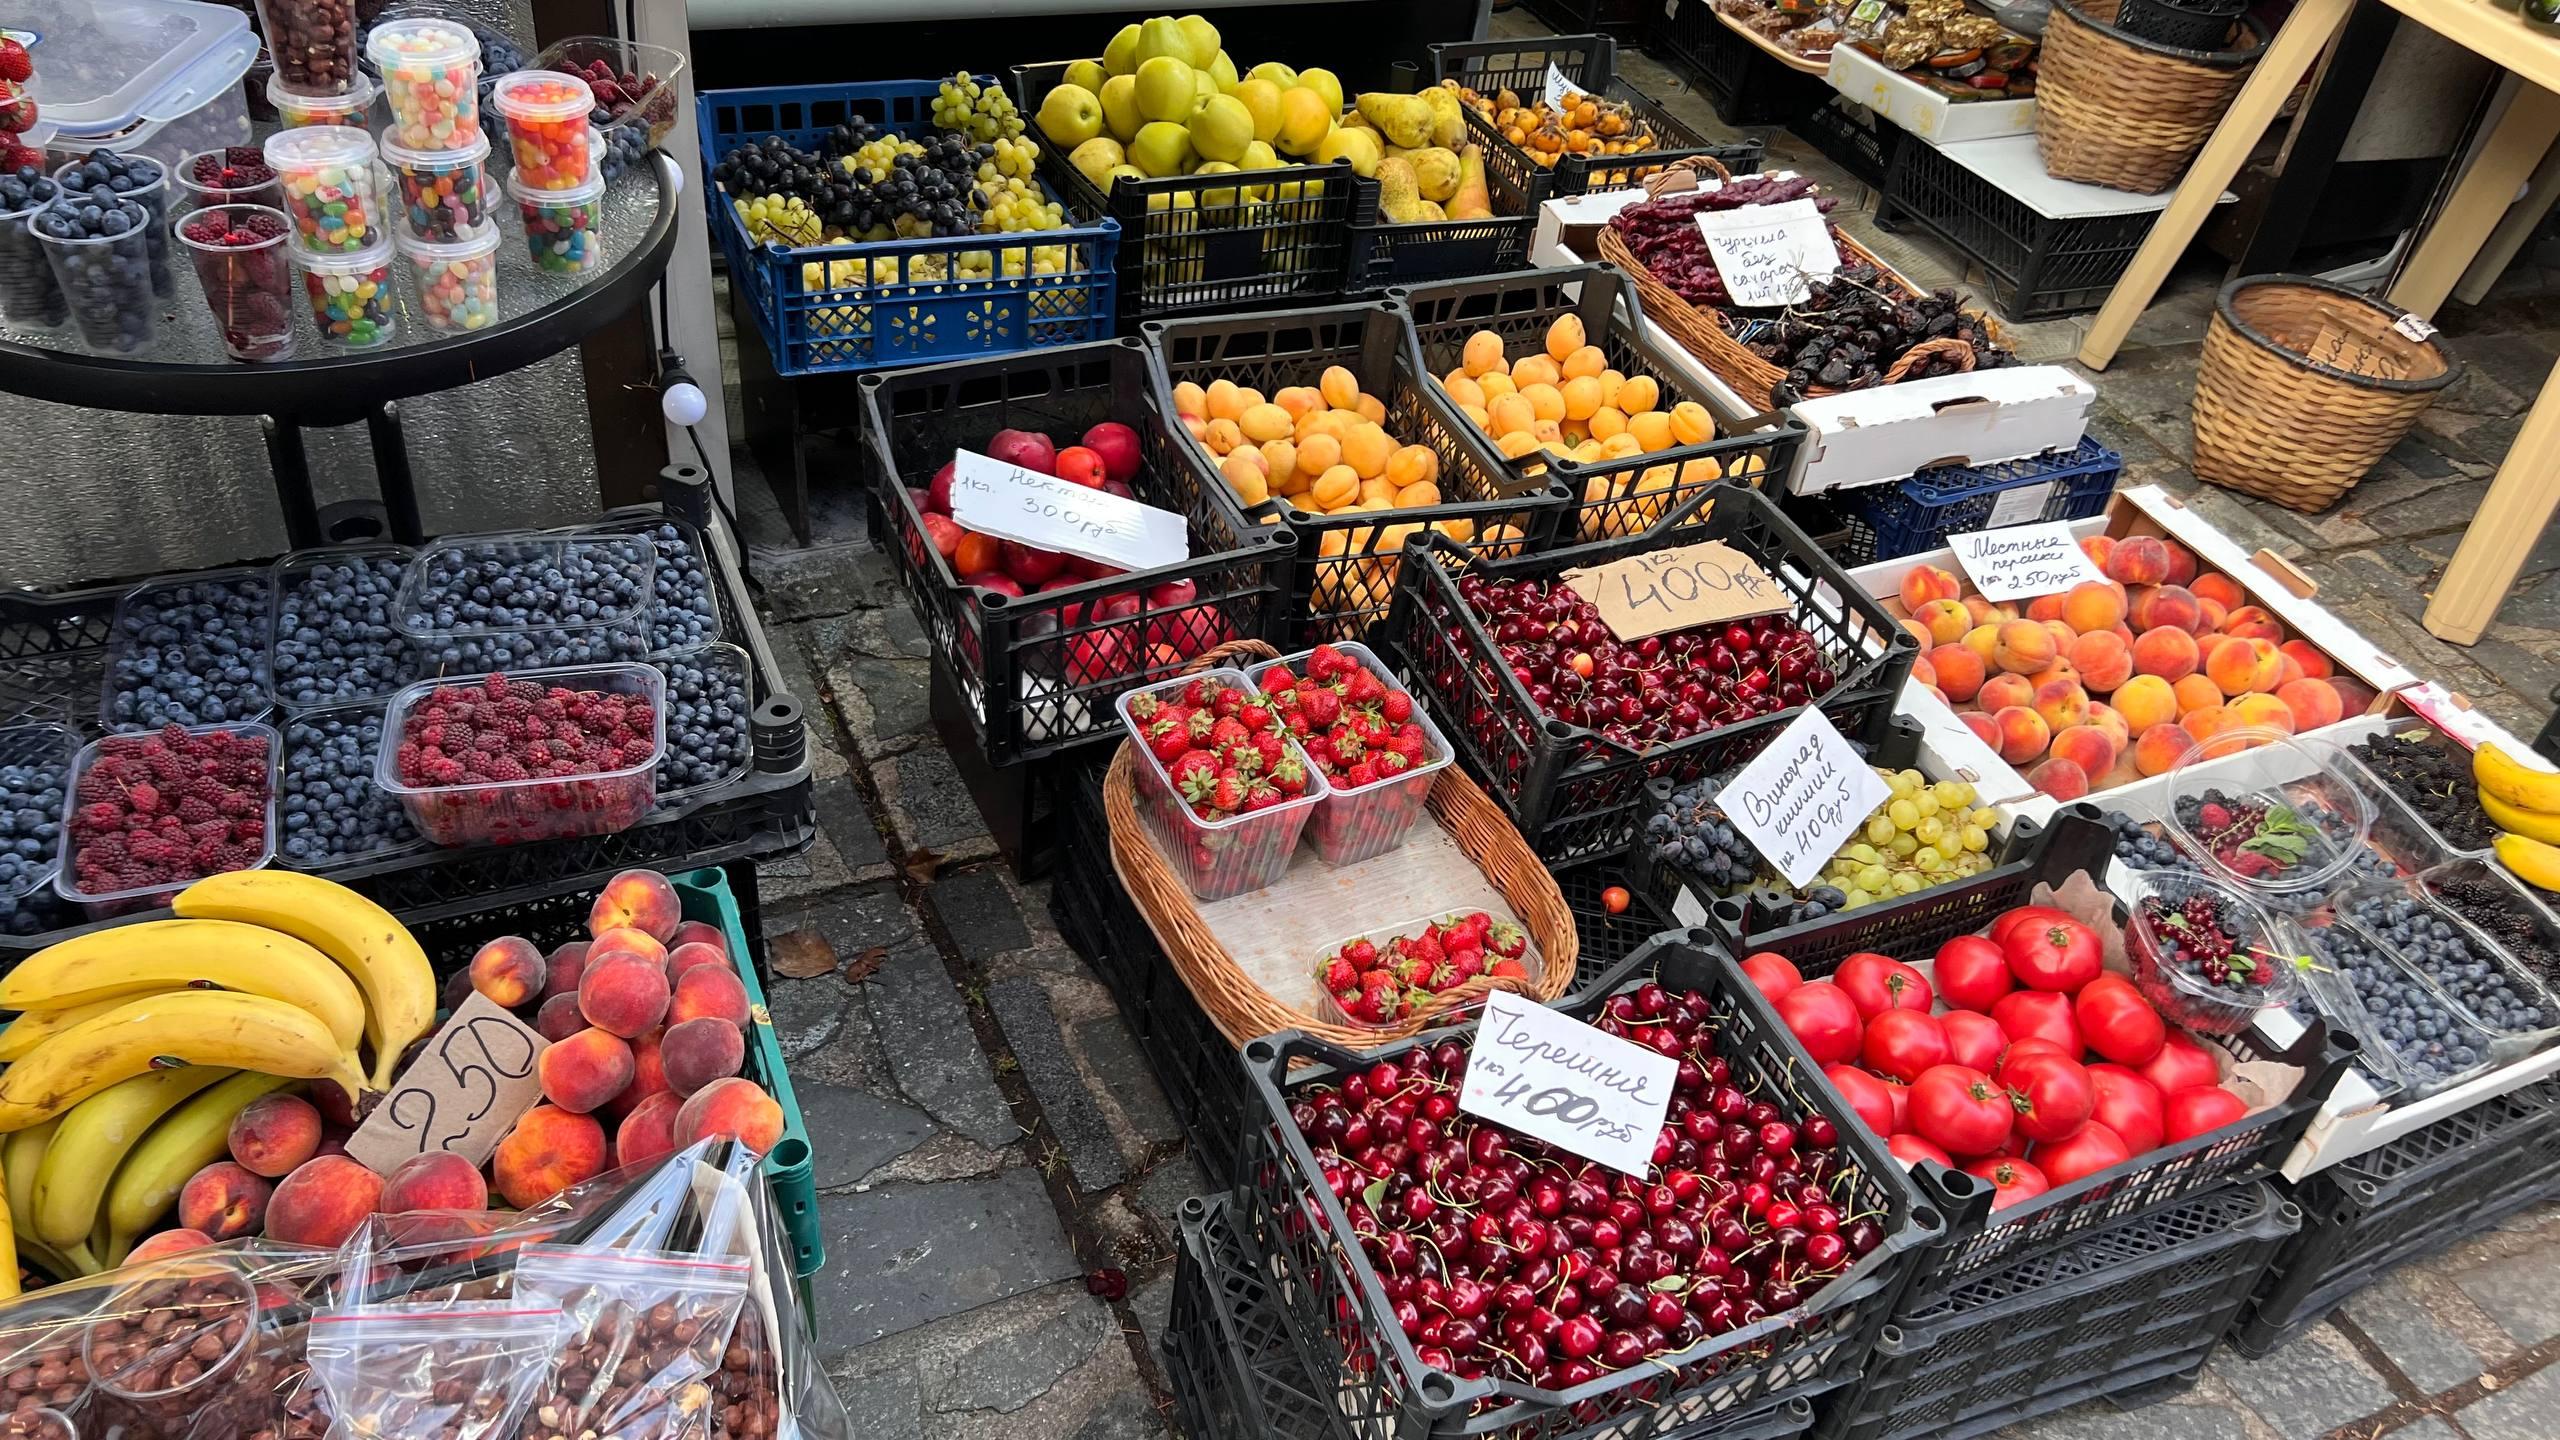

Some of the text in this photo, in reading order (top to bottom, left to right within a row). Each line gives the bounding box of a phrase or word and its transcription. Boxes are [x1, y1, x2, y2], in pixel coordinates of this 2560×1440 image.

[1741, 250, 1777, 268] без
[1968, 536, 2070, 559] Местные
[1992, 552, 2064, 571] персики
[1743, 734, 1824, 828] Виноград
[1490, 1005, 1660, 1107] Черешня
